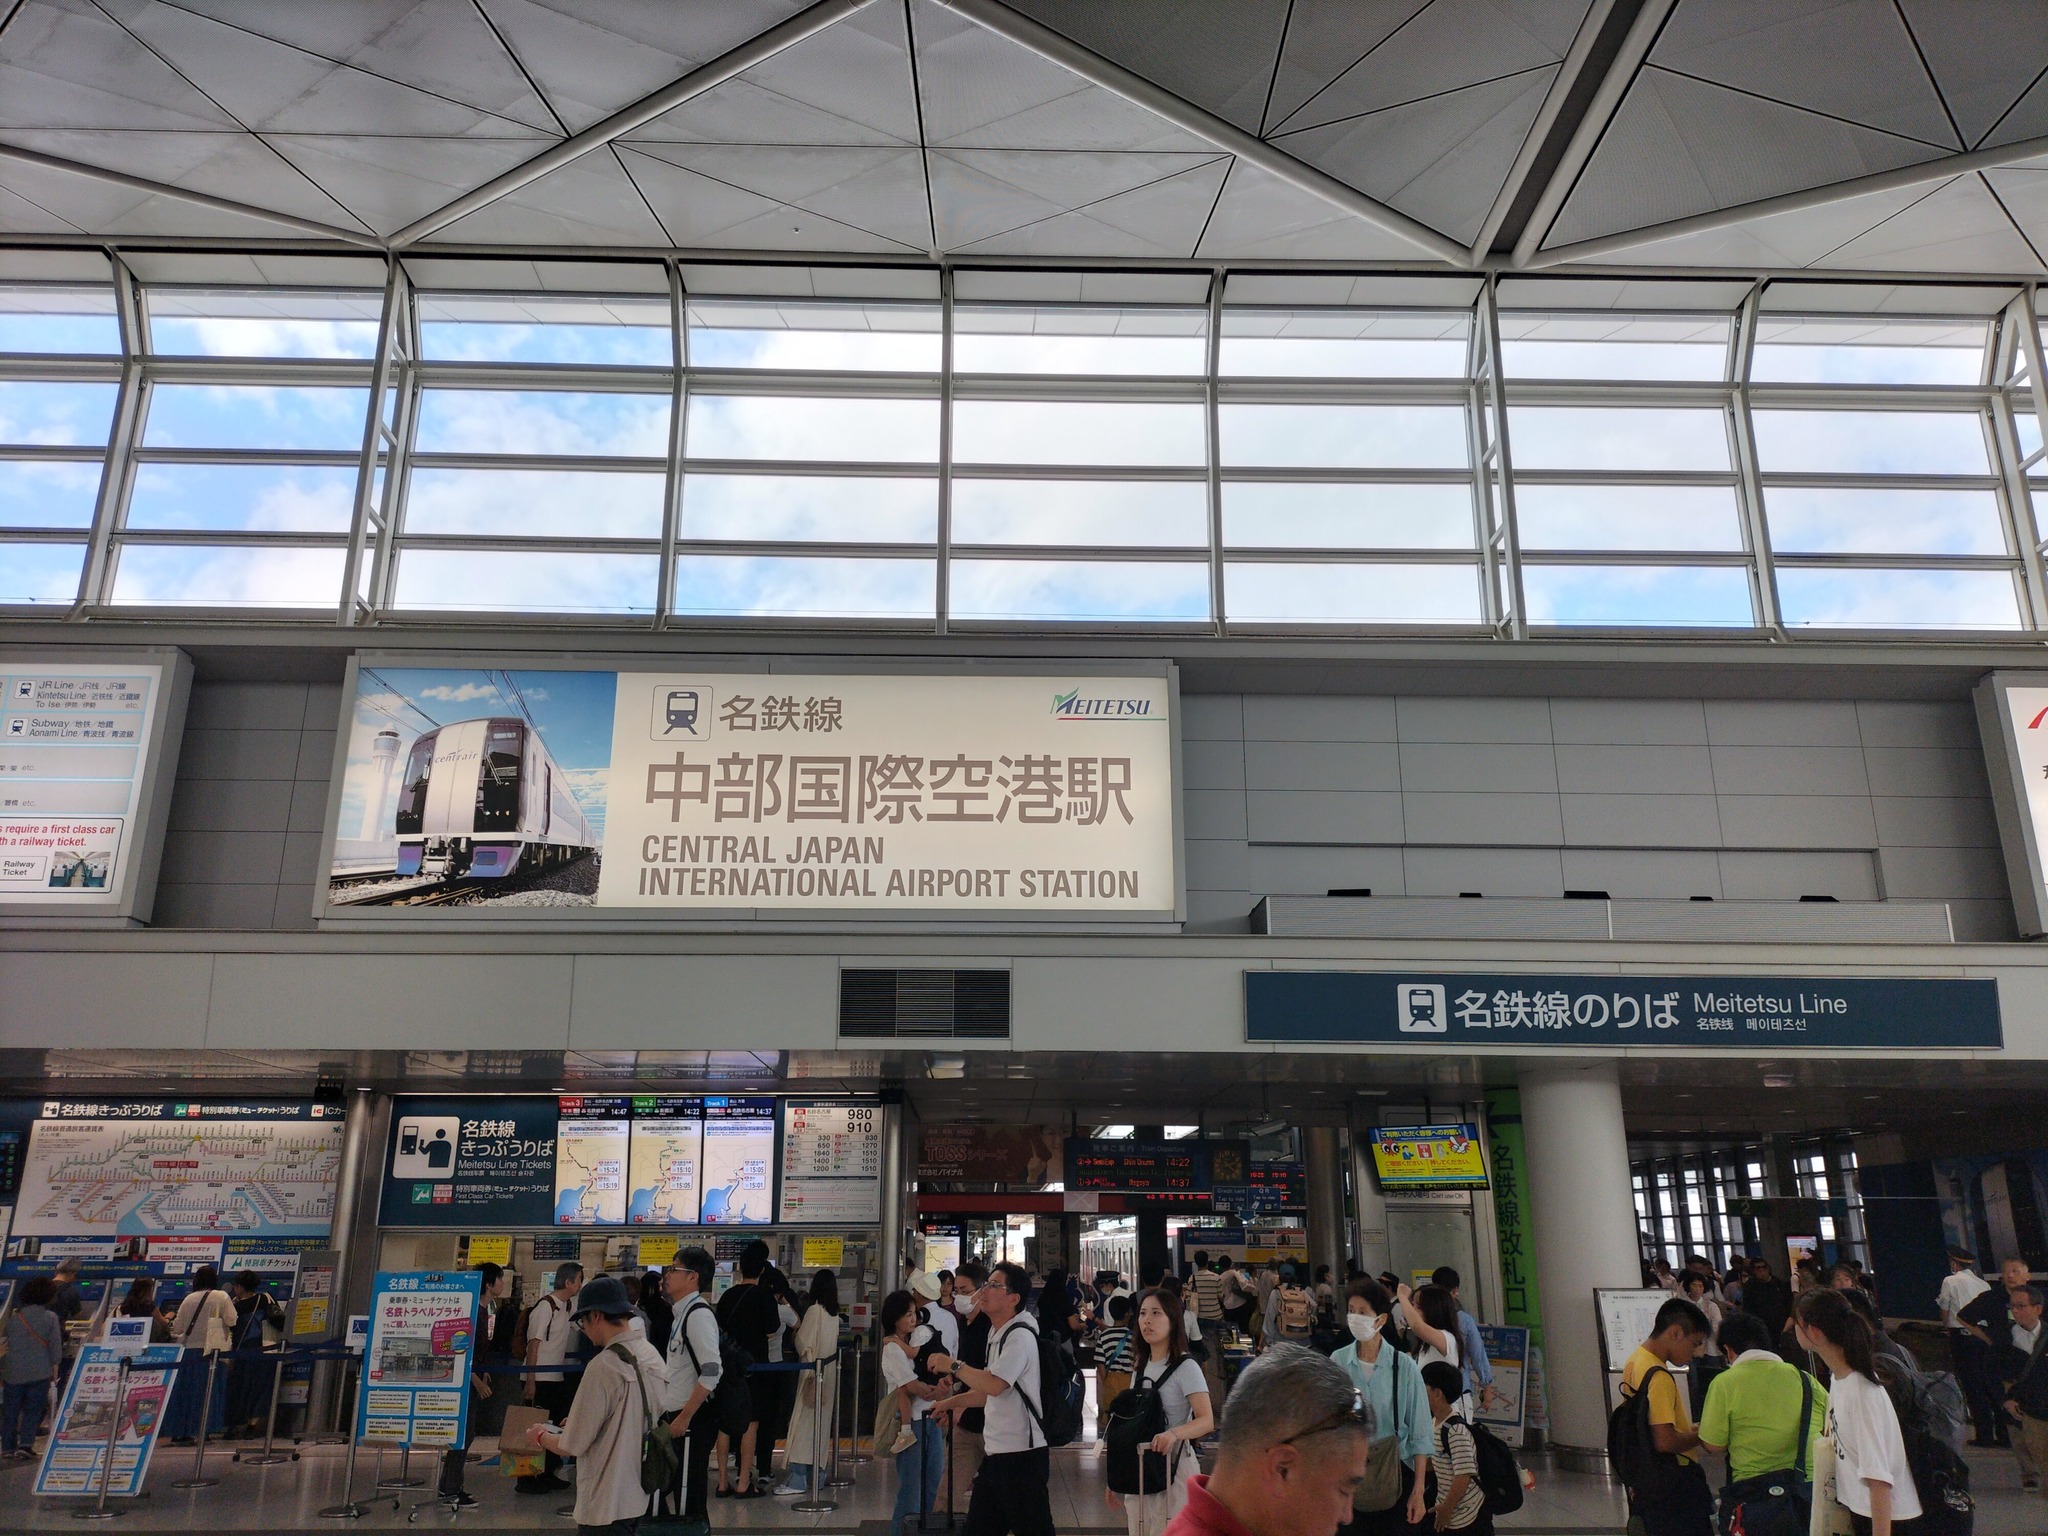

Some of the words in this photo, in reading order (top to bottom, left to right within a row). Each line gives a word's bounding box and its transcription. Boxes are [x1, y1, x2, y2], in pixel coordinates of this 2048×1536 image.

[39, 681, 52, 690] JR
[54, 681, 74, 690] Line
[36, 692, 69, 700] Kintetsu
[70, 692, 87, 700] Line
[1050, 686, 1150, 717] MEITETSU
[719, 695, 843, 733] 名鉄線
[31, 719, 70, 728] Subway
[29, 728, 60, 737] Aonami
[61, 729, 78, 737] Line
[645, 751, 1135, 826] 中部国際空港駅
[5, 825, 39, 835] require
[51, 825, 70, 834] first
[73, 825, 97, 834] class
[19, 837, 55, 847] railway
[57, 838, 87, 846] ticket.
[642, 836, 776, 864] CENTRAL
[786, 836, 885, 865] JAPAN
[638, 867, 877, 897] INTERNATIONAL
[886, 870, 1011, 897] AIRPORT
[1018, 870, 1140, 899] STATION
[1693, 992, 1793, 1014] Meitetsu
[1800, 993, 1848, 1014] Line
[1454, 989, 1680, 1030] 名鉄線のりば
[1746, 1018, 1807, 1032] 메이테츠선
[61, 1104, 163, 1117] 名鉄線きっぷうりば
[848, 1109, 872, 1120] 980
[462, 1120, 516, 1138] 名鉄線
[847, 1122, 872, 1133] 910
[461, 1139, 555, 1157] きっぷうりば
[925, 1145, 967, 1162] TOSS
[967, 1149, 1008, 1161] シリーズ
[1157, 1145, 1186, 1153] Departure
[458, 1160, 496, 1169] Meitetsu
[499, 1160, 518, 1169] Line
[520, 1160, 552, 1169] Tickets
[1166, 1159, 1190, 1167] 14:22
[1166, 1179, 1190, 1187] 14:37
[1493, 1145, 1528, 1312] 名鉄線改札口
[388, 1278, 419, 1290] 名鉄線
[112, 1324, 143, 1334] 入口
